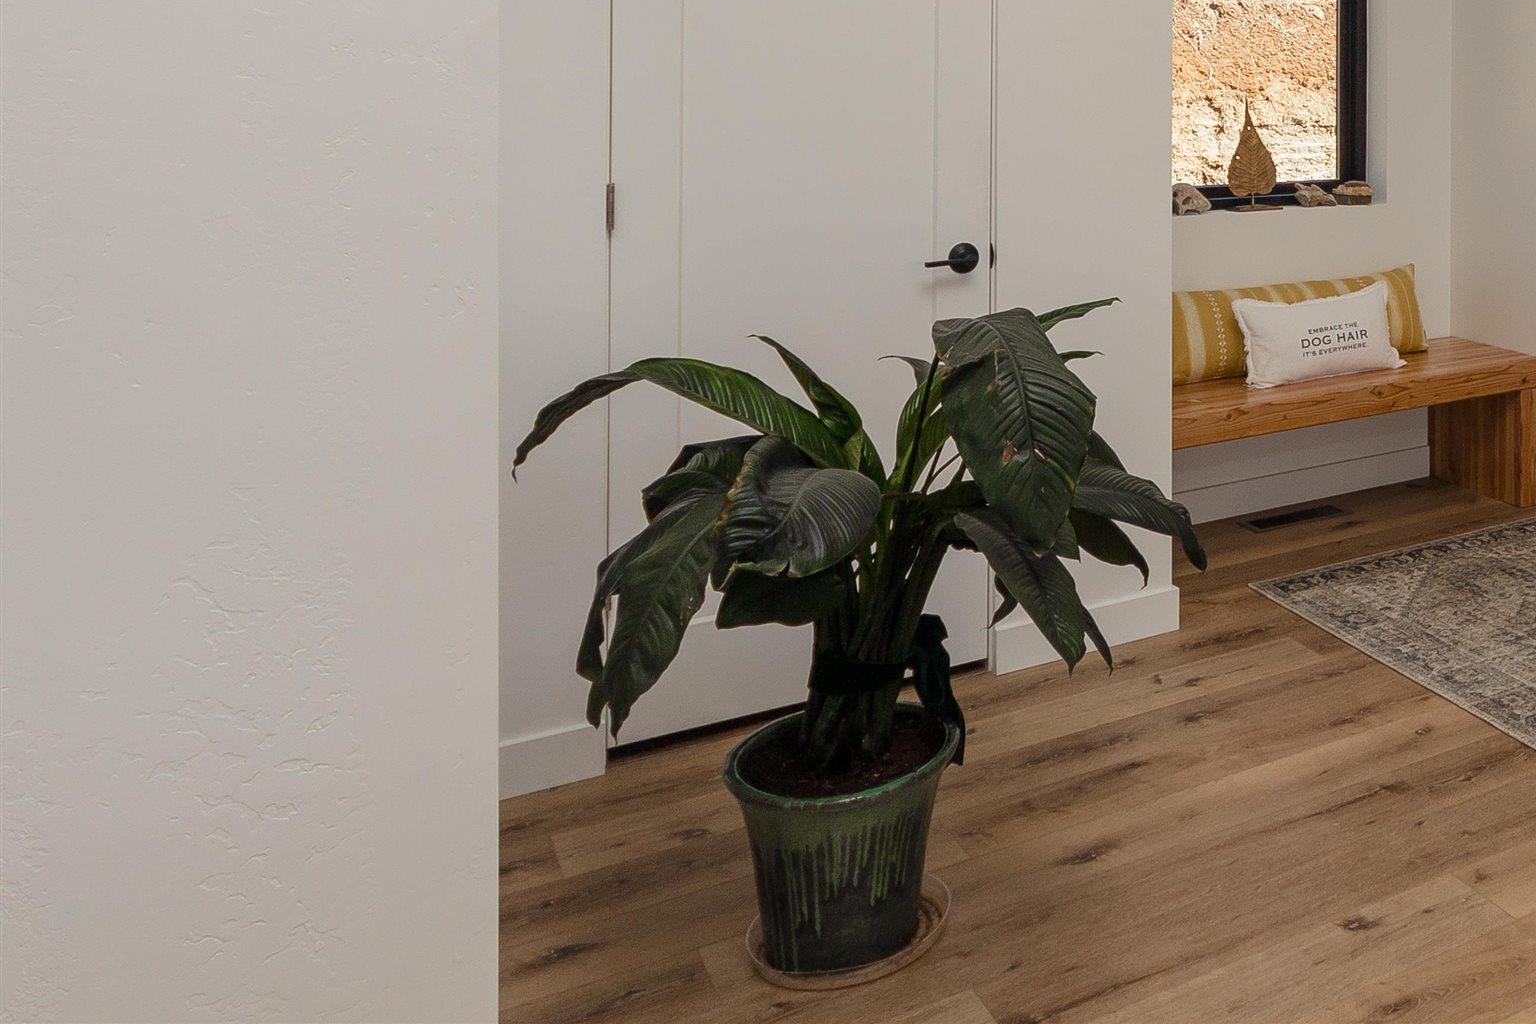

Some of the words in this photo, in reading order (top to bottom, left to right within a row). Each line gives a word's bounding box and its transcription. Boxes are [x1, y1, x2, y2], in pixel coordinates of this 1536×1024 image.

[1308, 324, 1343, 335] EMBRACE
[1301, 335, 1332, 349] DOG
[1336, 329, 1368, 343] HAIR
[1302, 350, 1317, 358] IT'S
[1318, 342, 1369, 355] EVERYWHERE.
